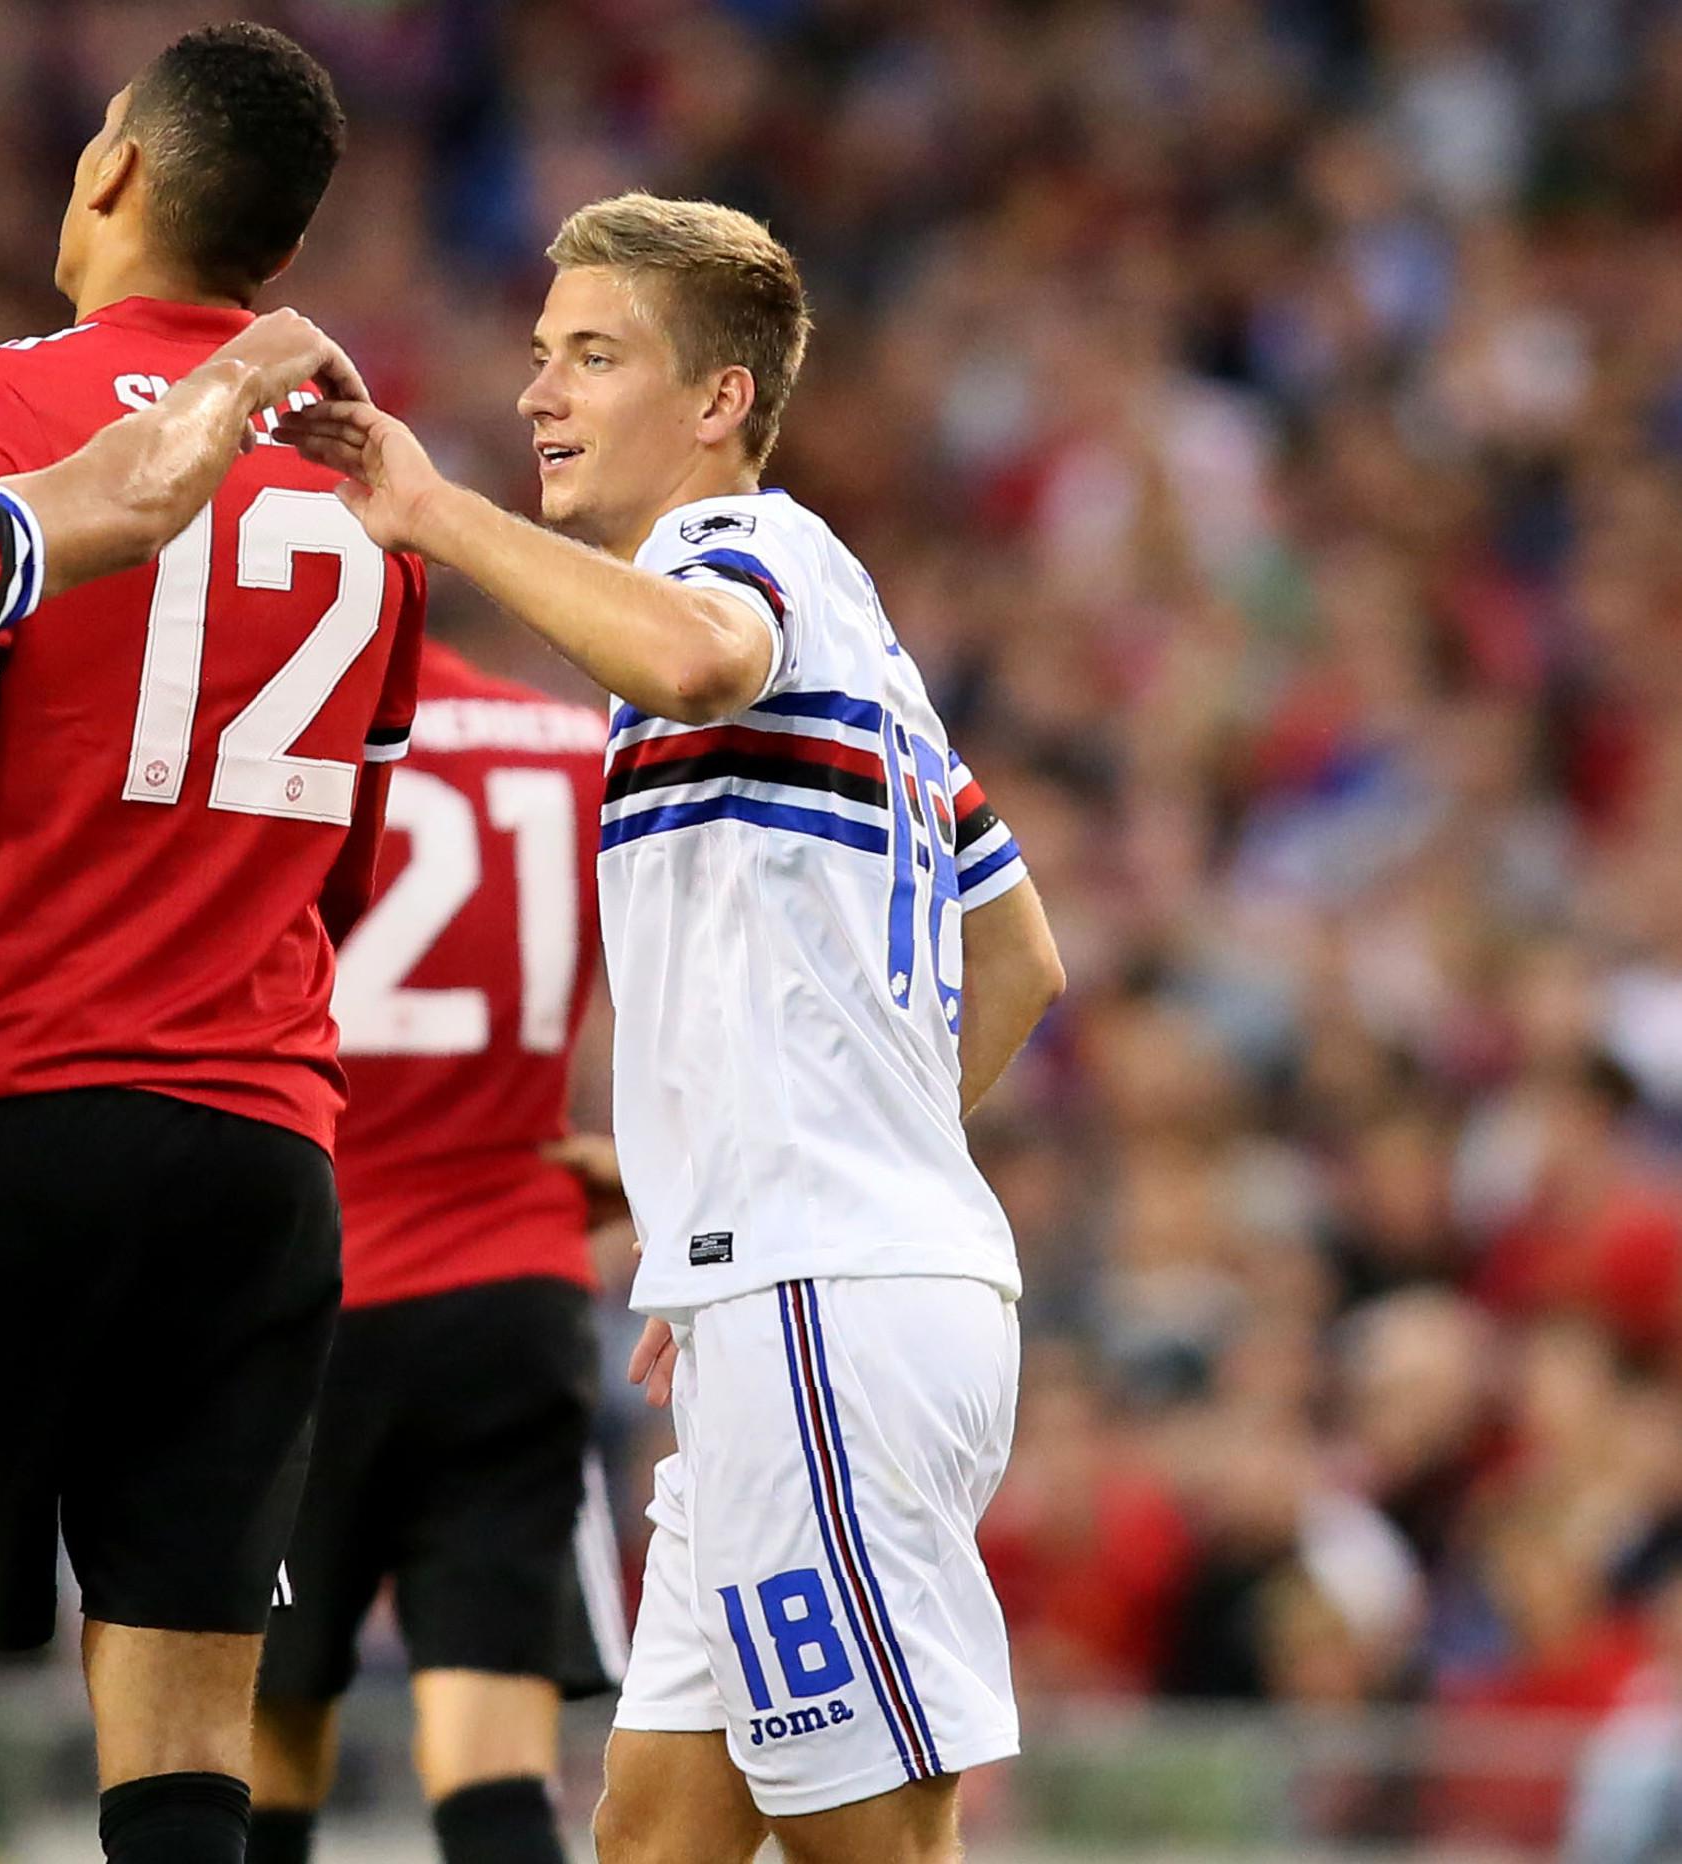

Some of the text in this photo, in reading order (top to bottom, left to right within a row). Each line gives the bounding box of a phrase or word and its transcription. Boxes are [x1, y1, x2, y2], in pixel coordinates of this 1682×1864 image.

[121, 486, 385, 827] 12
[328, 766, 581, 1056] 21
[880, 706, 963, 1037] 18
[715, 1567, 855, 1711] 18
